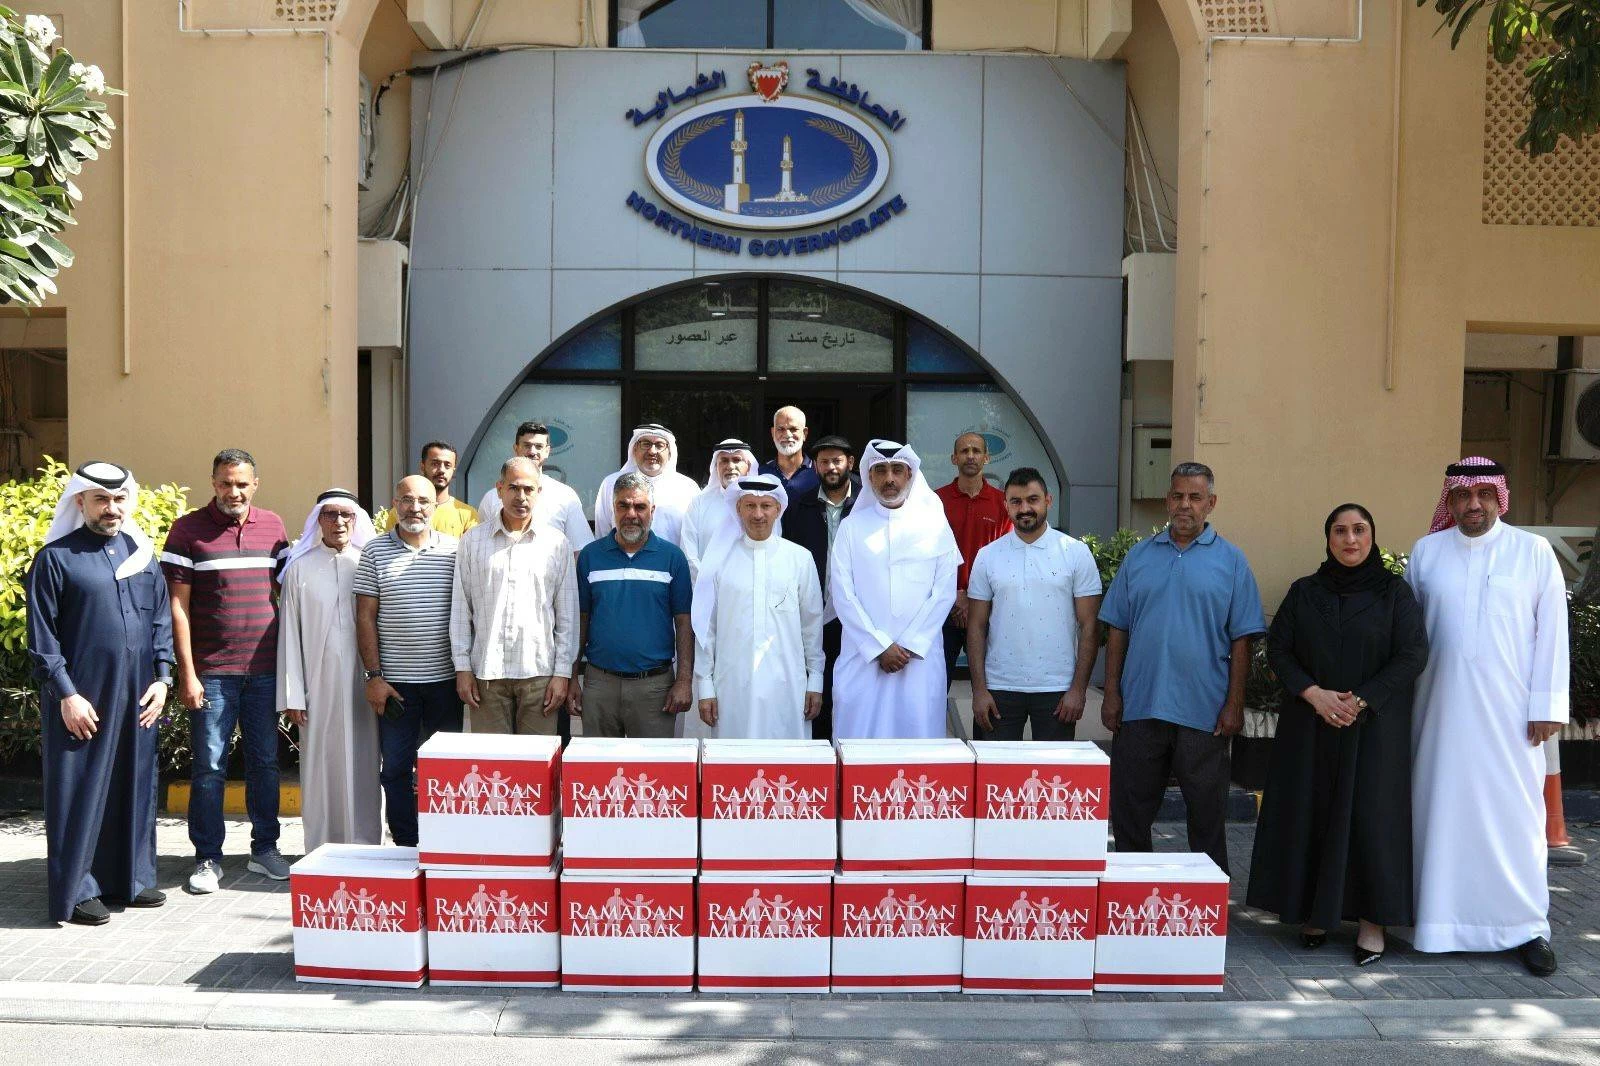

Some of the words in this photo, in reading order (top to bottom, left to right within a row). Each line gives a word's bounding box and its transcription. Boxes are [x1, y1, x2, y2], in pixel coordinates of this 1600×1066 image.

[625, 70, 726, 127] الشمالية
[806, 68, 907, 132] المحافظة
[626, 190, 741, 256] NORTHERN
[748, 194, 908, 257] GOVERNORATE
[666, 329, 711, 345] العصور
[716, 332, 738, 346] عبر
[787, 331, 818, 344] ممتد
[822, 331, 856, 350] تاريخ
[427, 779, 542, 799] RAMADAN
[571, 782, 688, 801] RAMADAN
[712, 784, 828, 803] RAMADAN
[852, 785, 968, 803] RAMADAN
[985, 784, 1102, 803] RAMADAN
[428, 796, 540, 816] MUBARAK
[573, 800, 686, 818] MUBARAK
[713, 803, 826, 820] MUBARAK
[853, 803, 965, 820] MUBARAK
[986, 803, 1100, 820] MUBARAK
[298, 894, 407, 916] RAMADAN
[434, 898, 548, 917] RAMADAN
[569, 902, 685, 921] RAMADAN
[707, 903, 823, 922] RAMADAN
[842, 903, 956, 921] RAMADAN
[975, 905, 1090, 924] RAMADAN
[1107, 901, 1221, 920] RAMADAN
[301, 912, 405, 933] MUBARAK
[436, 915, 546, 934] MUBARAK
[571, 920, 681, 938] MUBARAK
[709, 921, 821, 939] MUBARAK
[843, 921, 954, 938] MUBARAK
[1107, 921, 1217, 937] MUBARAK
[975, 924, 1086, 941] MUBARAK
